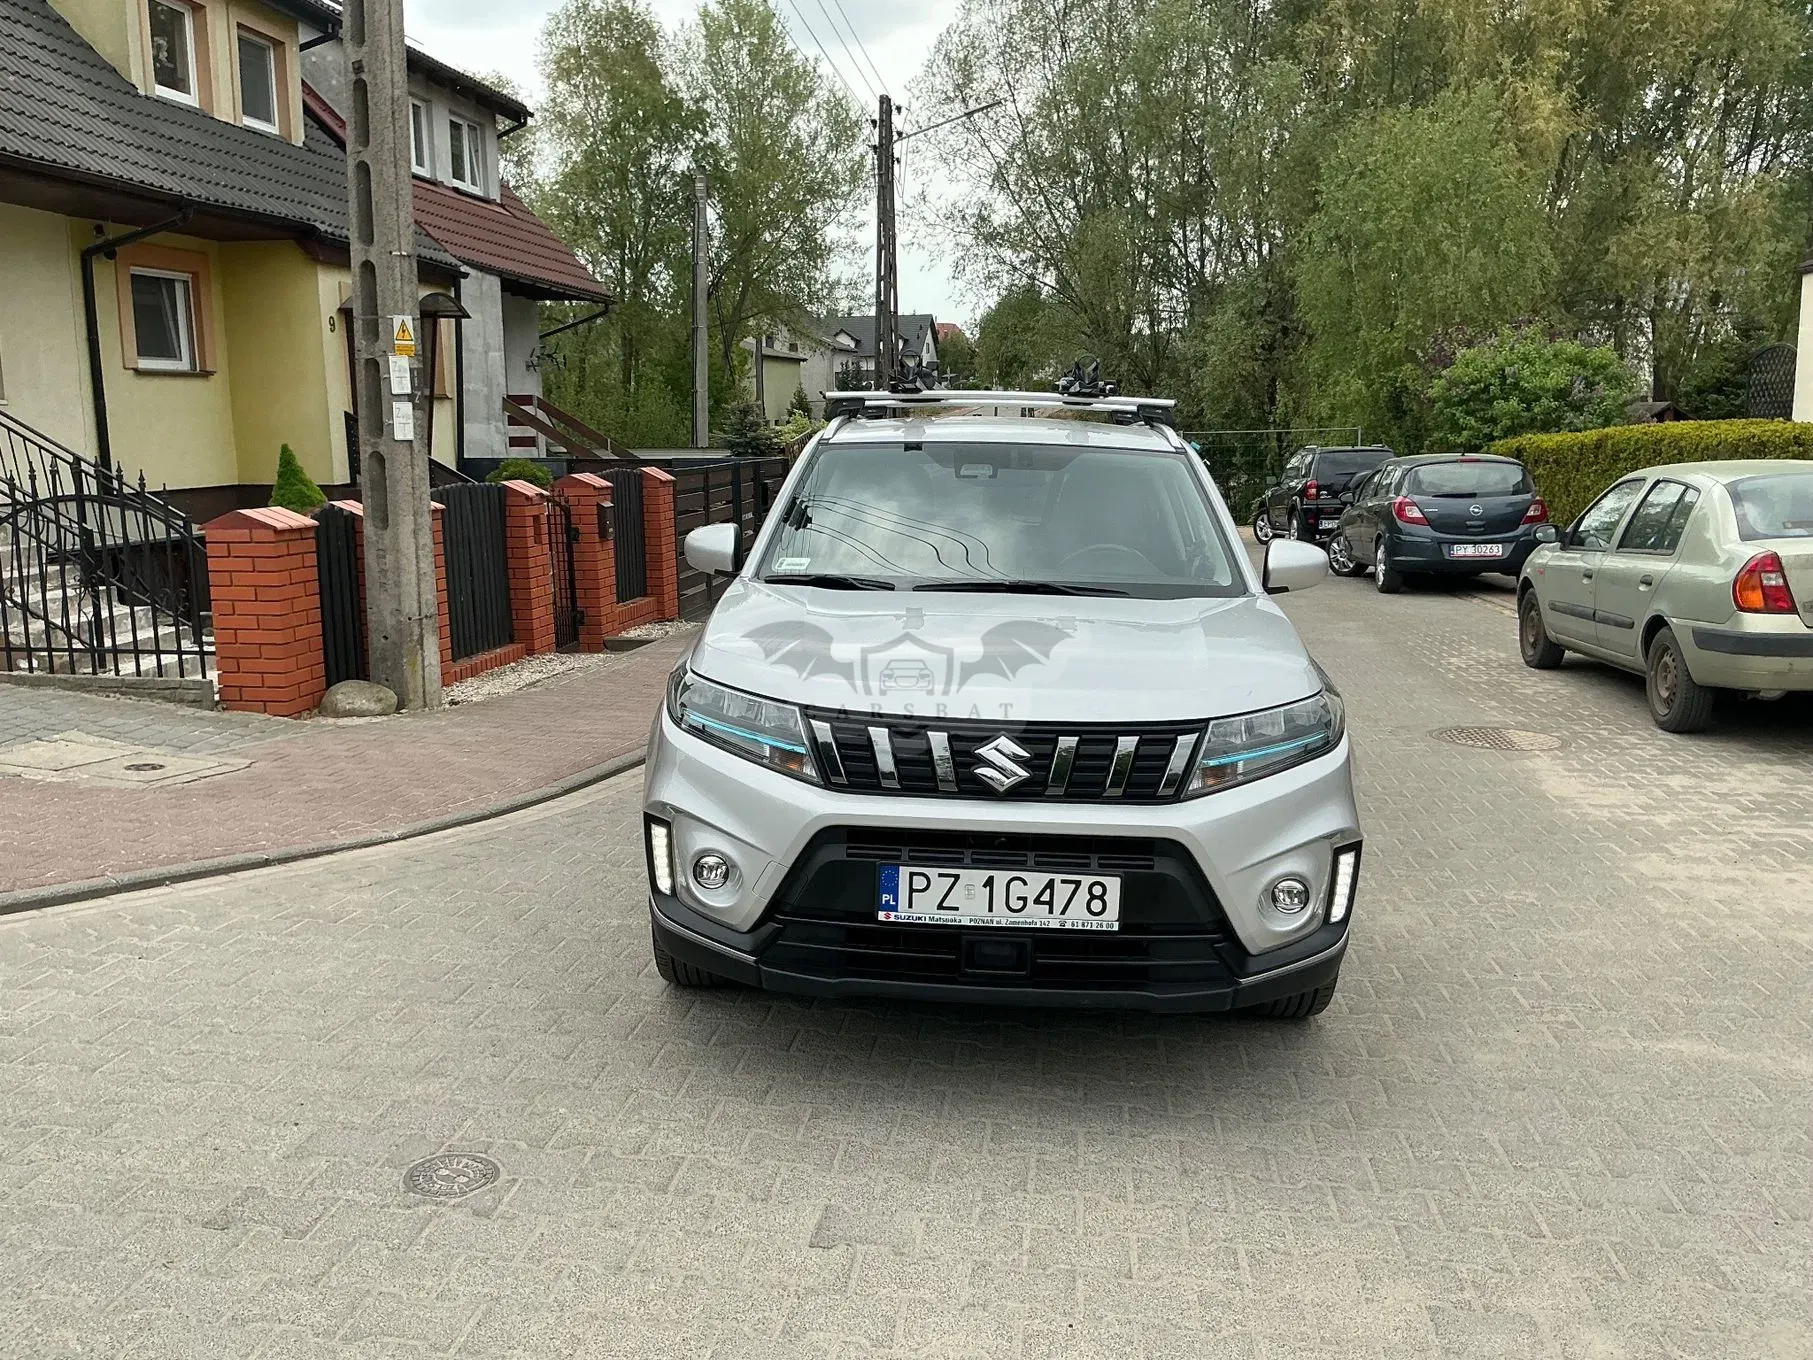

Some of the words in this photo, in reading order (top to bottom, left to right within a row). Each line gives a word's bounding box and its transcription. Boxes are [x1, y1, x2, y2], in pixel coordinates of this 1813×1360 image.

[328, 315, 336, 333] 9
[1455, 545, 1468, 554] PY
[1471, 545, 1500, 554] 30263
[881, 893, 896, 905] PL
[907, 871, 961, 911] PZ
[981, 874, 1108, 917] 1G478
[893, 914, 927, 922] SUZUKI
[928, 916, 962, 924] Matsuoka
[1070, 920, 1079, 928] 61
